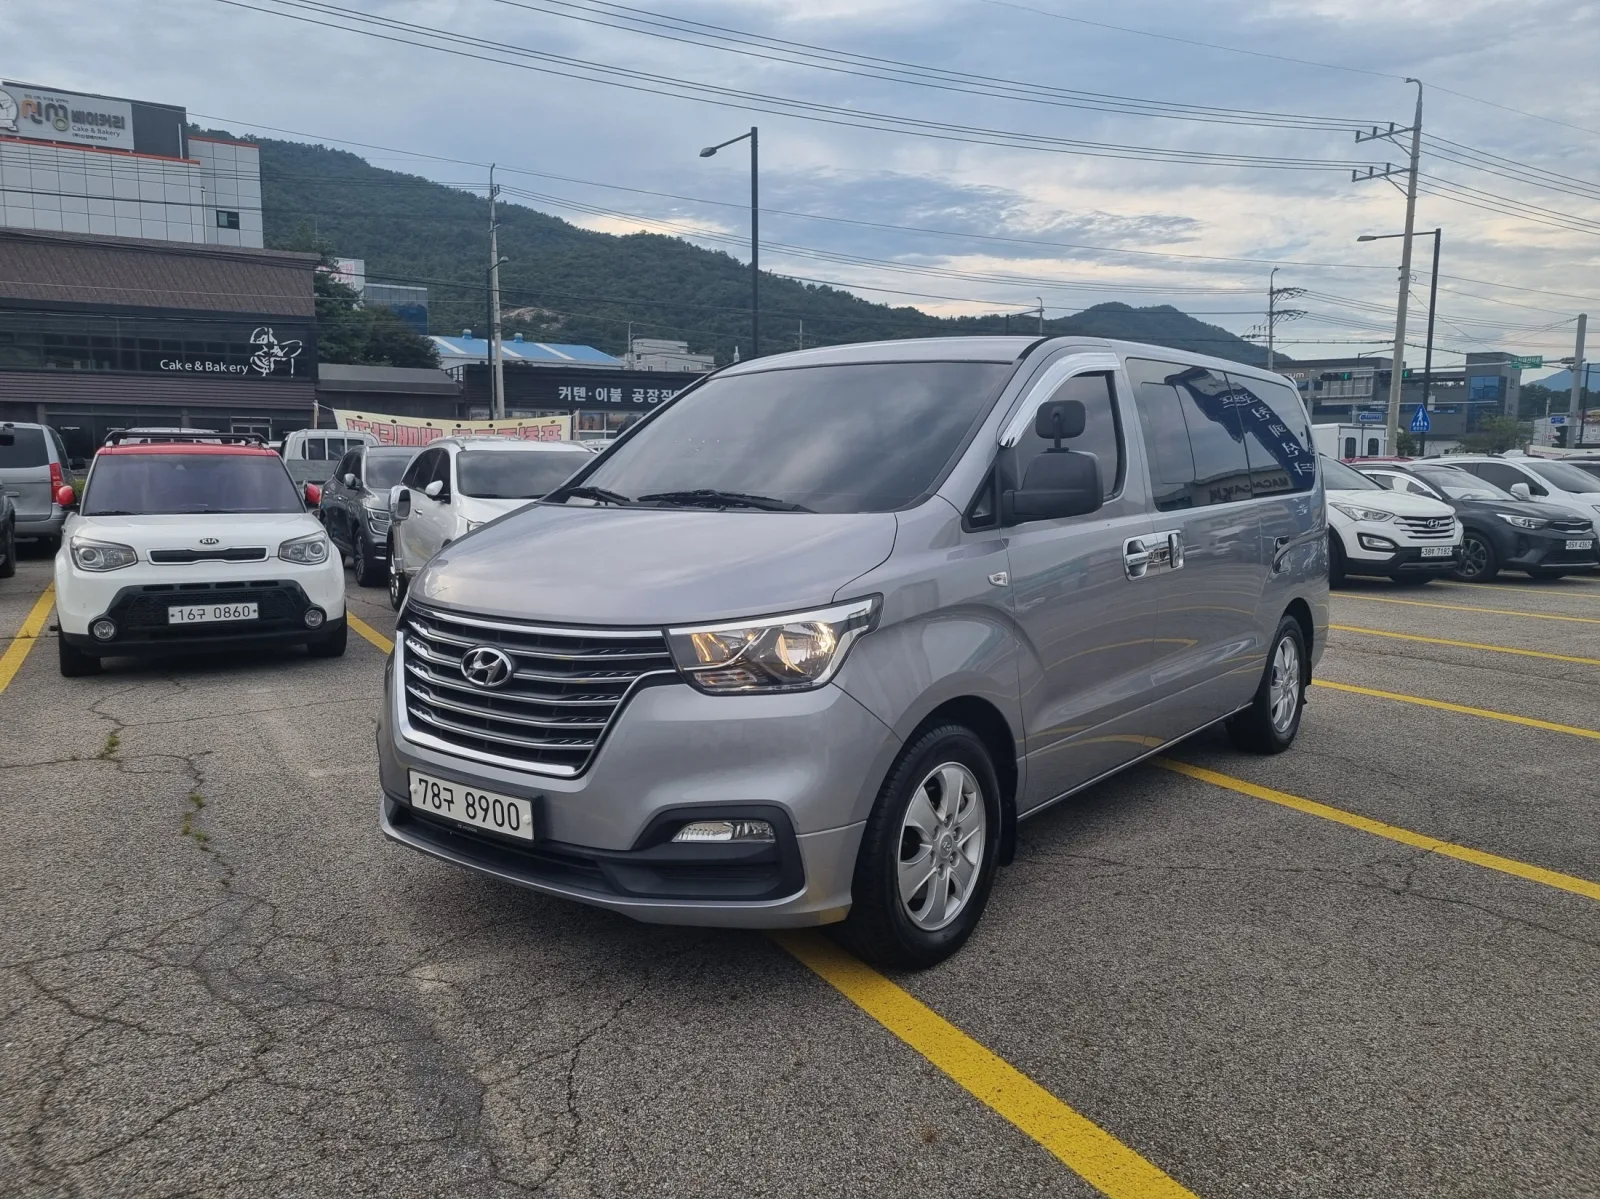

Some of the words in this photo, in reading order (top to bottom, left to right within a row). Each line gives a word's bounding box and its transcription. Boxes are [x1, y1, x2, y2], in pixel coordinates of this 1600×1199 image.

[71, 110, 125, 130] 베이커리
[72, 125, 88, 133] Cake
[98, 128, 120, 137] Bakery
[178, 608, 206, 621] 16구
[213, 606, 250, 619] 0860
[418, 777, 455, 813] 78구
[464, 791, 521, 832] 8900
